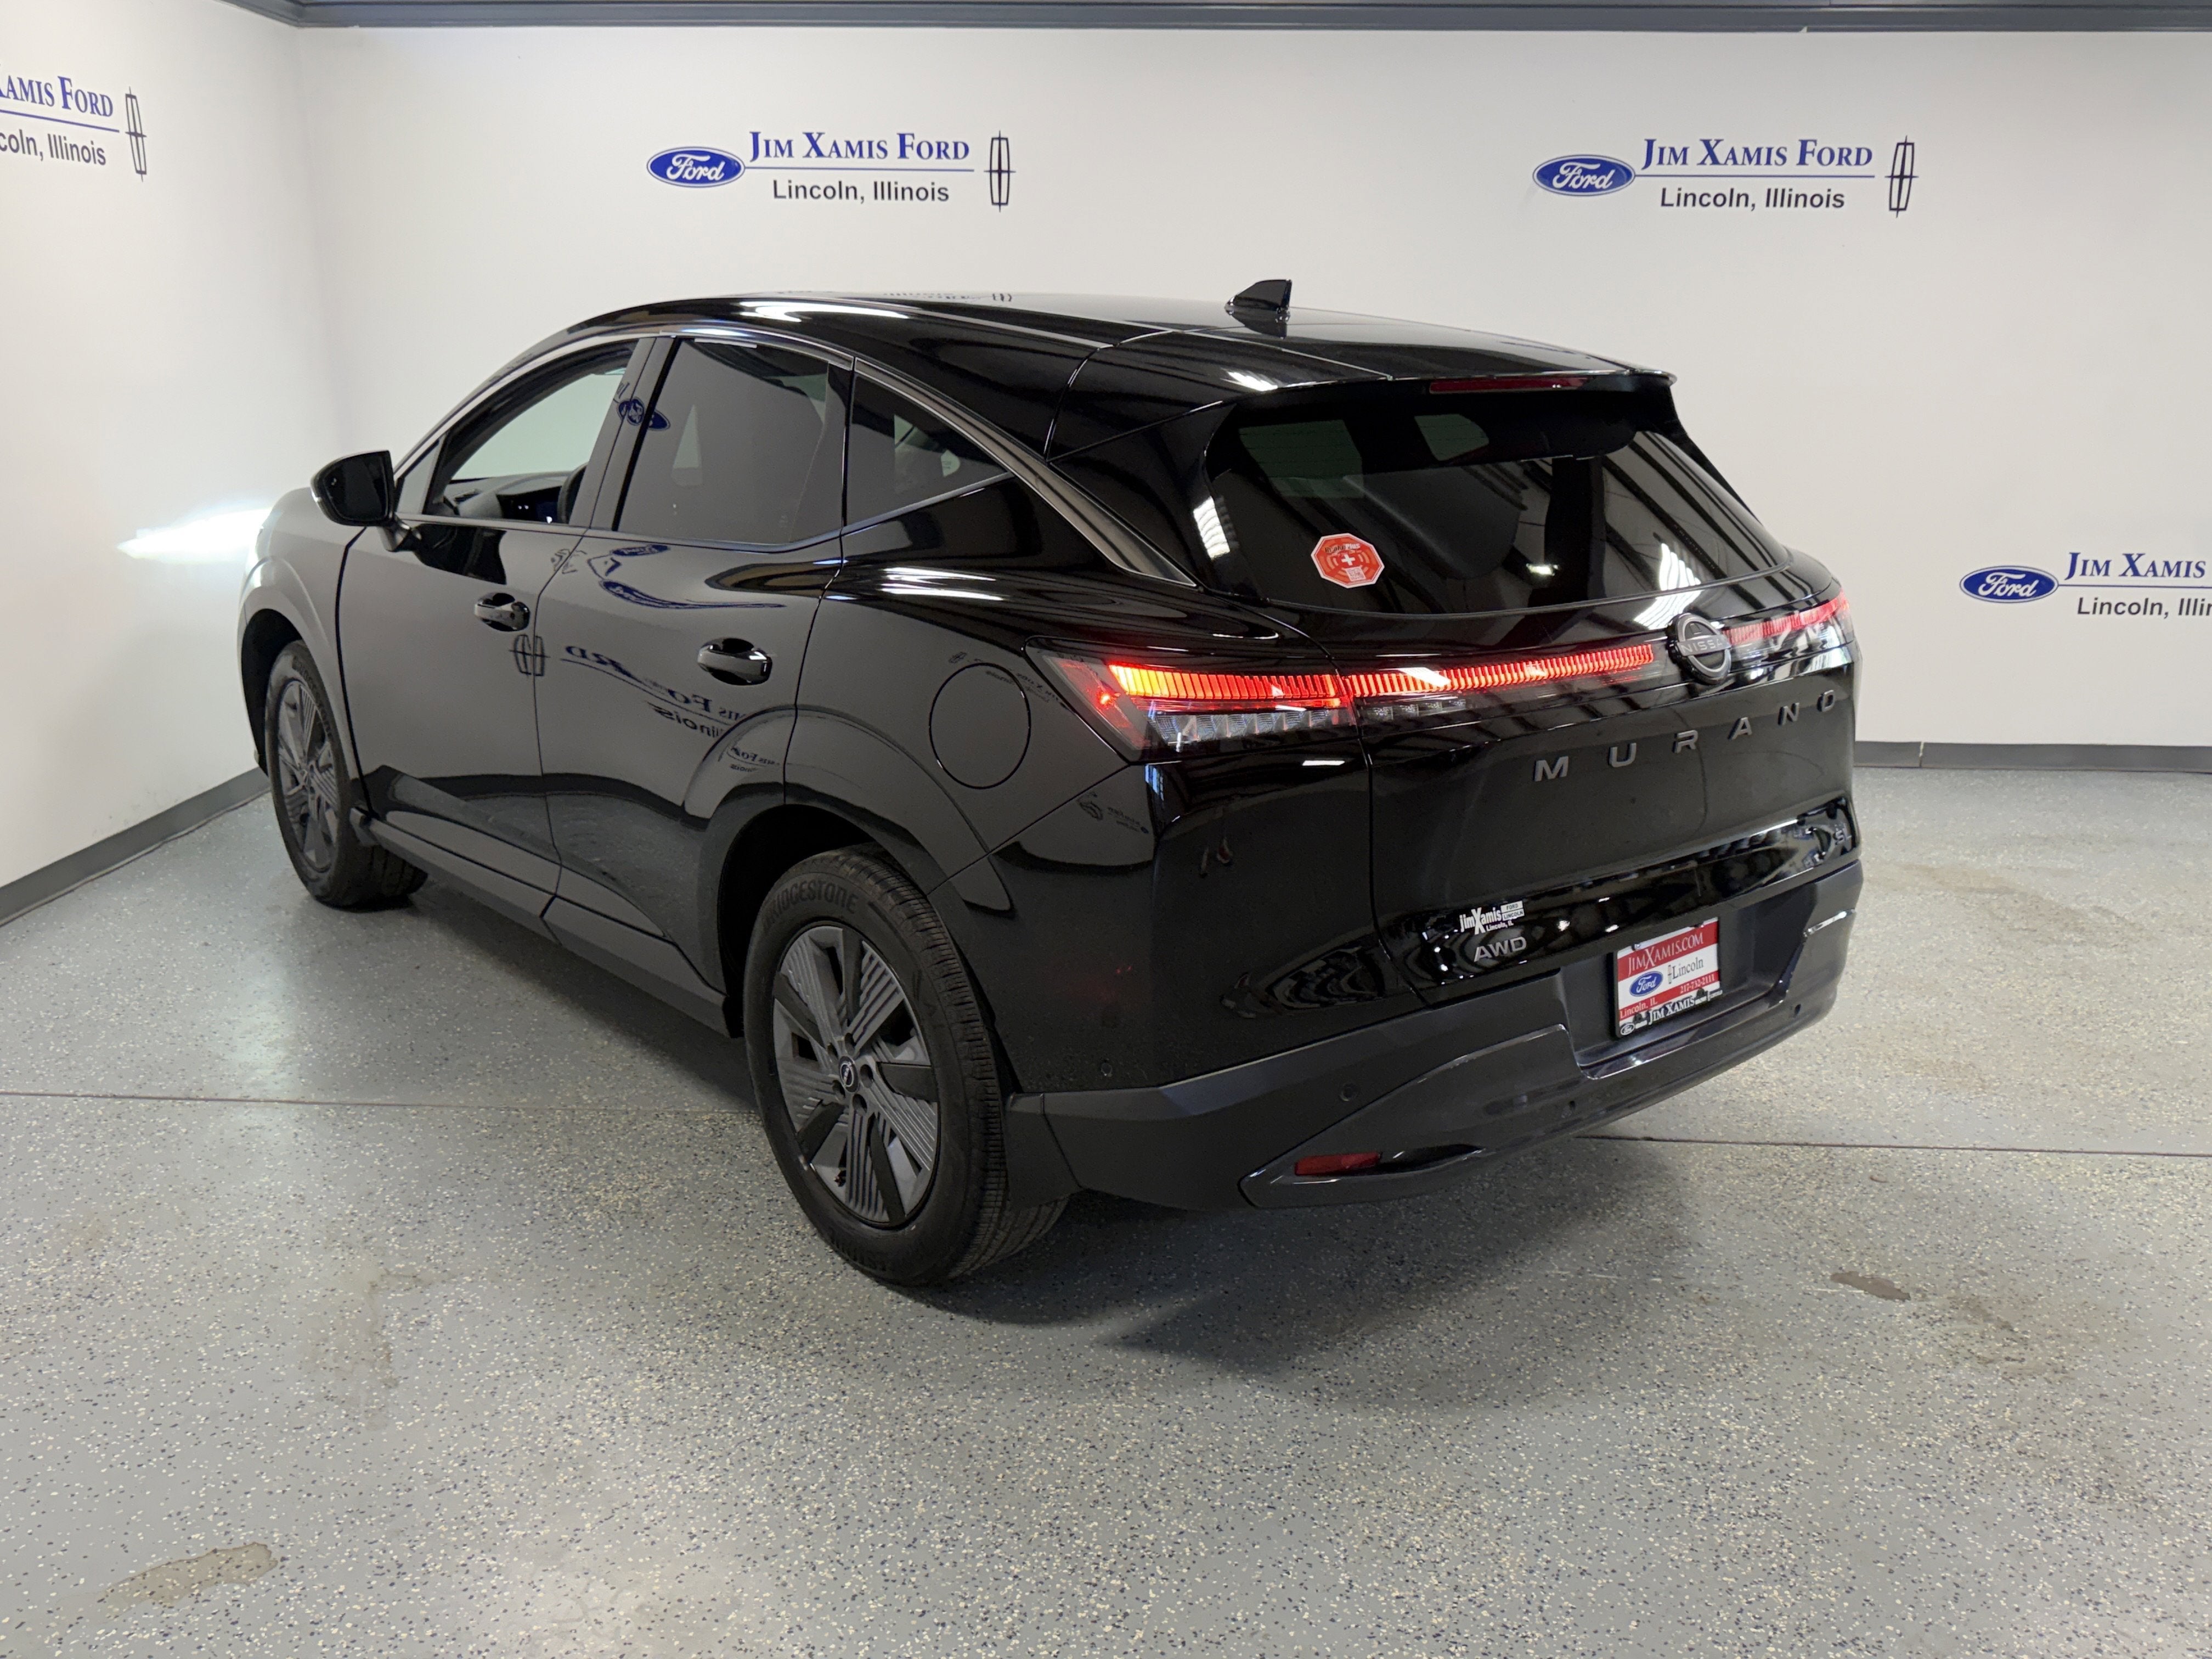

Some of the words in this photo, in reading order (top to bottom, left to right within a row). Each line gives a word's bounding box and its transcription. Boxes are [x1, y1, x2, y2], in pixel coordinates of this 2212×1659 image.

[57, 76, 113, 117] FORD
[47, 133, 106, 166] Illinois
[749, 132, 793, 162] JIM
[803, 132, 888, 160] XAMIS
[897, 133, 969, 160] FORD
[1641, 139, 1689, 170] JIM
[1697, 139, 1787, 166] XAMIS
[1796, 139, 1872, 166] FORD
[666, 154, 725, 181] Ford
[1553, 162, 1615, 189] Ford
[772, 180, 865, 204] Lincoln,
[873, 181, 949, 202] Illinois
[1660, 188, 1756, 211] Lincoln,
[1765, 188, 1845, 209] Illinois
[2064, 552, 2112, 580] JIM
[2118, 552, 2206, 578] XAMIS
[1978, 572, 2038, 597] Ford
[2077, 597, 2169, 619] Lincoln,
[1680, 638, 1727, 653] NISSA
[1534, 690, 1835, 782] MURANO
[1486, 922, 1508, 932] Lincoln,
[1504, 911, 1523, 919] LINCOLN
[1474, 936, 1527, 962] AWD
[1628, 933, 1703, 976] JIMXAMIS.COM
[1673, 957, 1703, 979] Lincoln
[1636, 975, 1657, 993] Ford
[1680, 974, 1715, 994] 217-732-2111
[1649, 1008, 1664, 1025] JIM
[1666, 997, 1695, 1017] XAMIS
[1650, 997, 1657, 1006] IL
